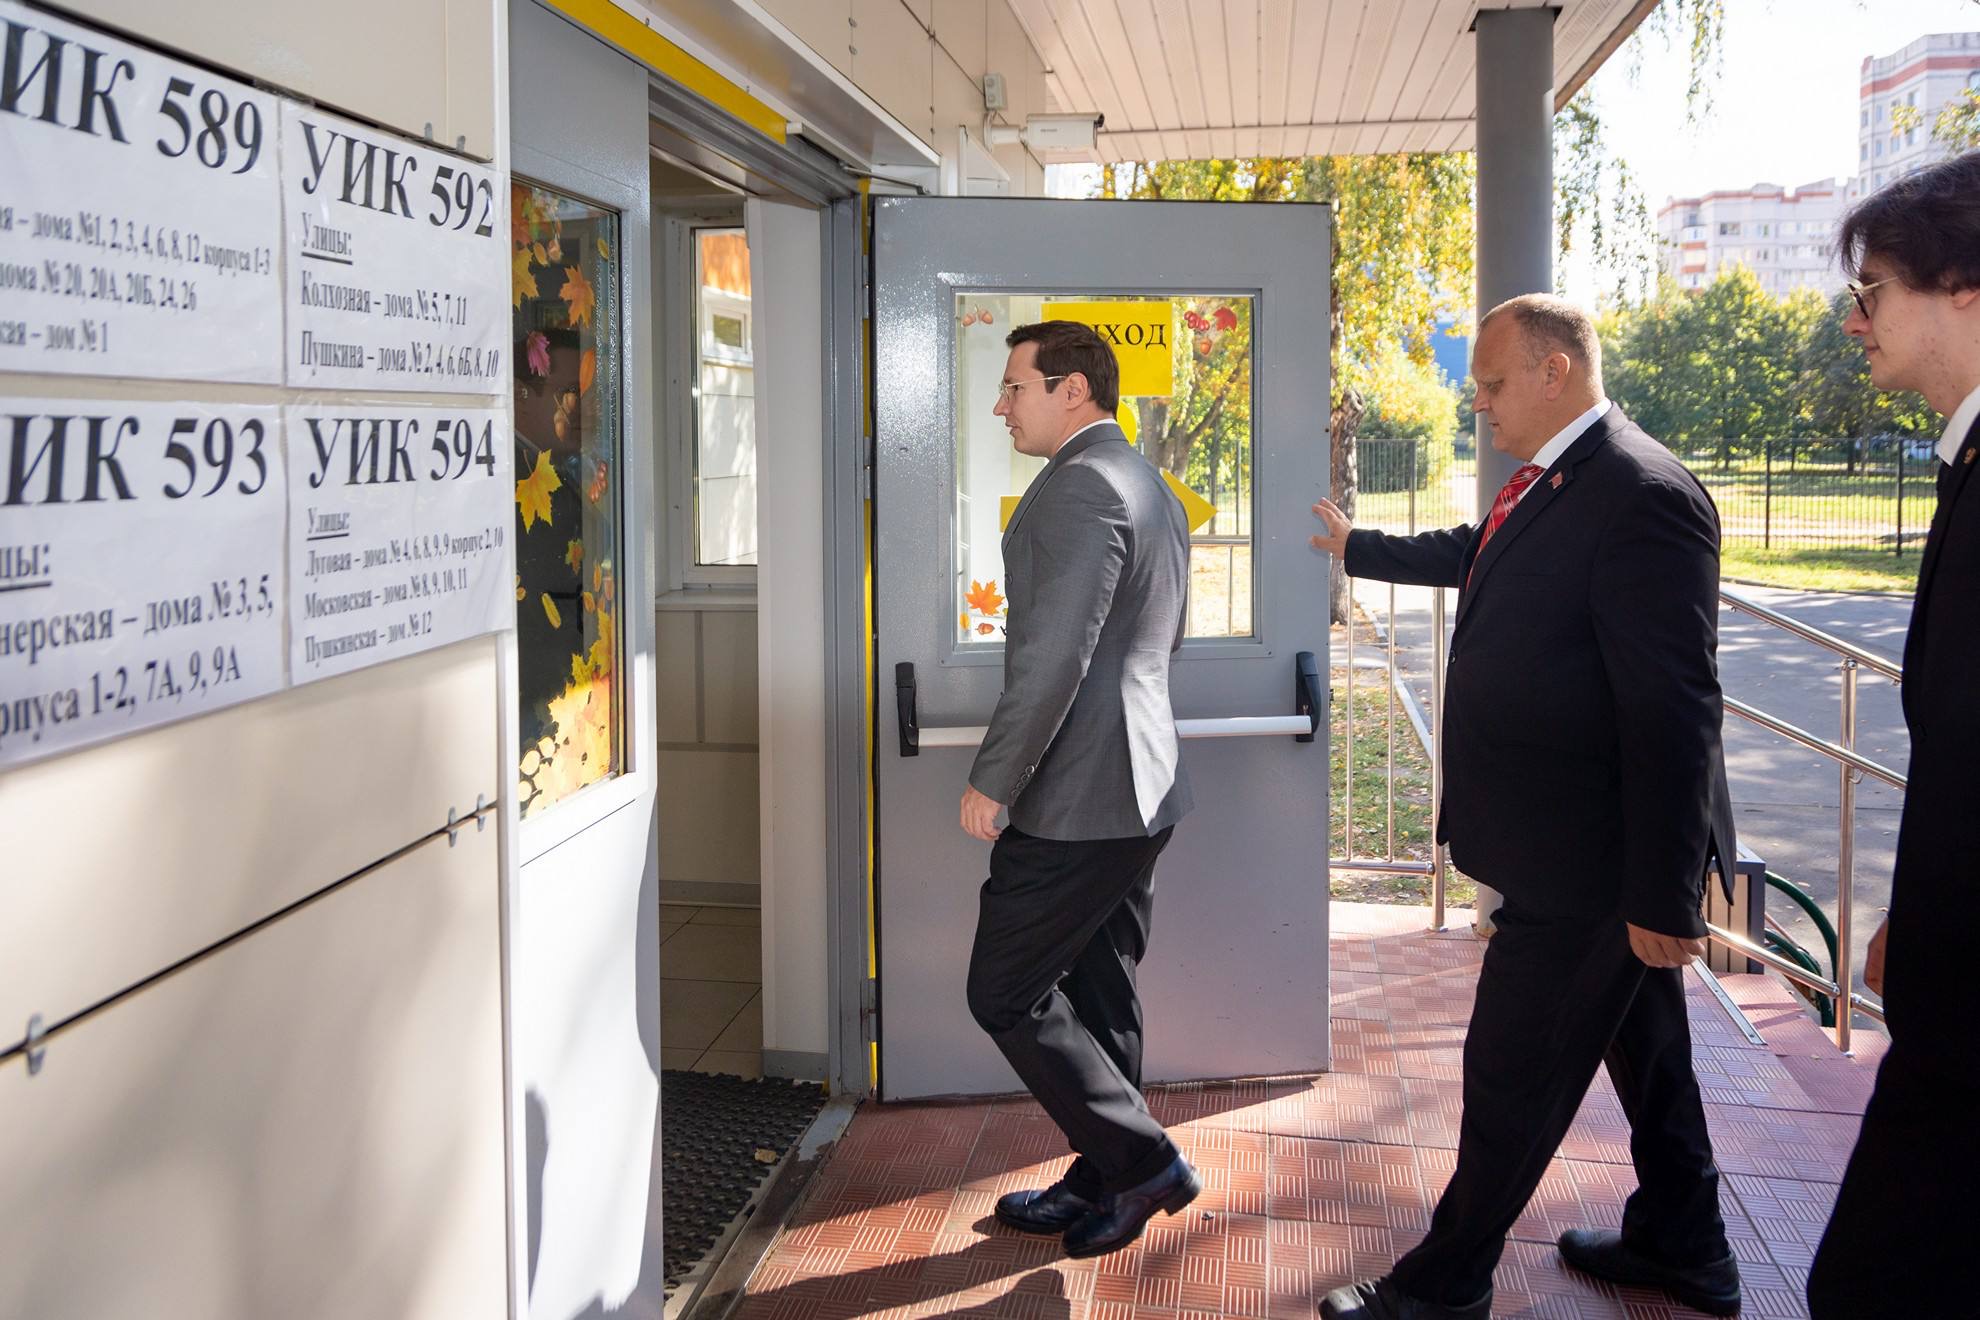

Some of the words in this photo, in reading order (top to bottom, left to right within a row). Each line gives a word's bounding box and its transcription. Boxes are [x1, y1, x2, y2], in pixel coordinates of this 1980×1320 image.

[157, 76, 262, 175] 589
[299, 119, 417, 219] УИК
[429, 165, 494, 238] 592
[32, 211, 72, 241] дома
[110, 217, 122, 256] 2,
[126, 220, 139, 258] 3,
[142, 224, 154, 261] 4,
[157, 227, 169, 264] 6,
[171, 230, 183, 266] 8,
[187, 233, 200, 262] 12
[204, 244, 250, 277] корпуса
[254, 246, 270, 275] 1-3
[301, 211, 352, 256] Улицы:
[41, 259, 60, 294] №
[64, 262, 86, 304] 20,
[90, 266, 122, 310] 20А,
[126, 271, 156, 312] 20Б,
[160, 277, 179, 316] 24,
[182, 280, 197, 311] 26
[301, 270, 372, 314] Колхозная
[384, 293, 413, 319] дома
[431, 292, 441, 328] 5,
[444, 293, 454, 330] 7,
[455, 295, 467, 326] 11
[44, 324, 75, 350] дом
[78, 318, 97, 352] №
[101, 320, 108, 352] 1
[301, 330, 364, 376] Пушкина
[377, 347, 407, 374] дома
[424, 342, 433, 380] 2,
[436, 344, 445, 381] 4,
[446, 344, 456, 382] 6,
[457, 345, 473, 383] 6Б,
[474, 347, 484, 384] 8,
[485, 348, 500, 378] 10
[0, 414, 140, 506] ИК
[162, 416, 267, 499] 593
[304, 418, 419, 489] УИК
[430, 418, 496, 482] 594
[304, 549, 352, 582] Луговая
[362, 546, 387, 569] дома
[413, 536, 422, 561] 6,
[423, 534, 432, 560] 8,
[433, 533, 443, 559] 9,
[443, 532, 450, 556] 9
[451, 534, 484, 560] корпус
[485, 527, 493, 552] 2,
[494, 525, 504, 548] 10
[143, 595, 202, 636] дома
[208, 579, 231, 622] №
[236, 576, 252, 622] 3,
[257, 573, 274, 619] 5,
[304, 590, 373, 620] Московская
[383, 583, 407, 606] дома
[422, 572, 431, 600] 8,
[432, 571, 442, 598] 9,
[443, 568, 457, 596] 10,
[458, 567, 468, 591] 11
[304, 629, 378, 668] Пушкинская
[387, 622, 406, 644] дом
[422, 610, 433, 636] 12
[91, 664, 136, 717] 1-2,
[144, 657, 184, 704] 7А,
[188, 650, 207, 698] 9,
[212, 644, 243, 686] 9А
